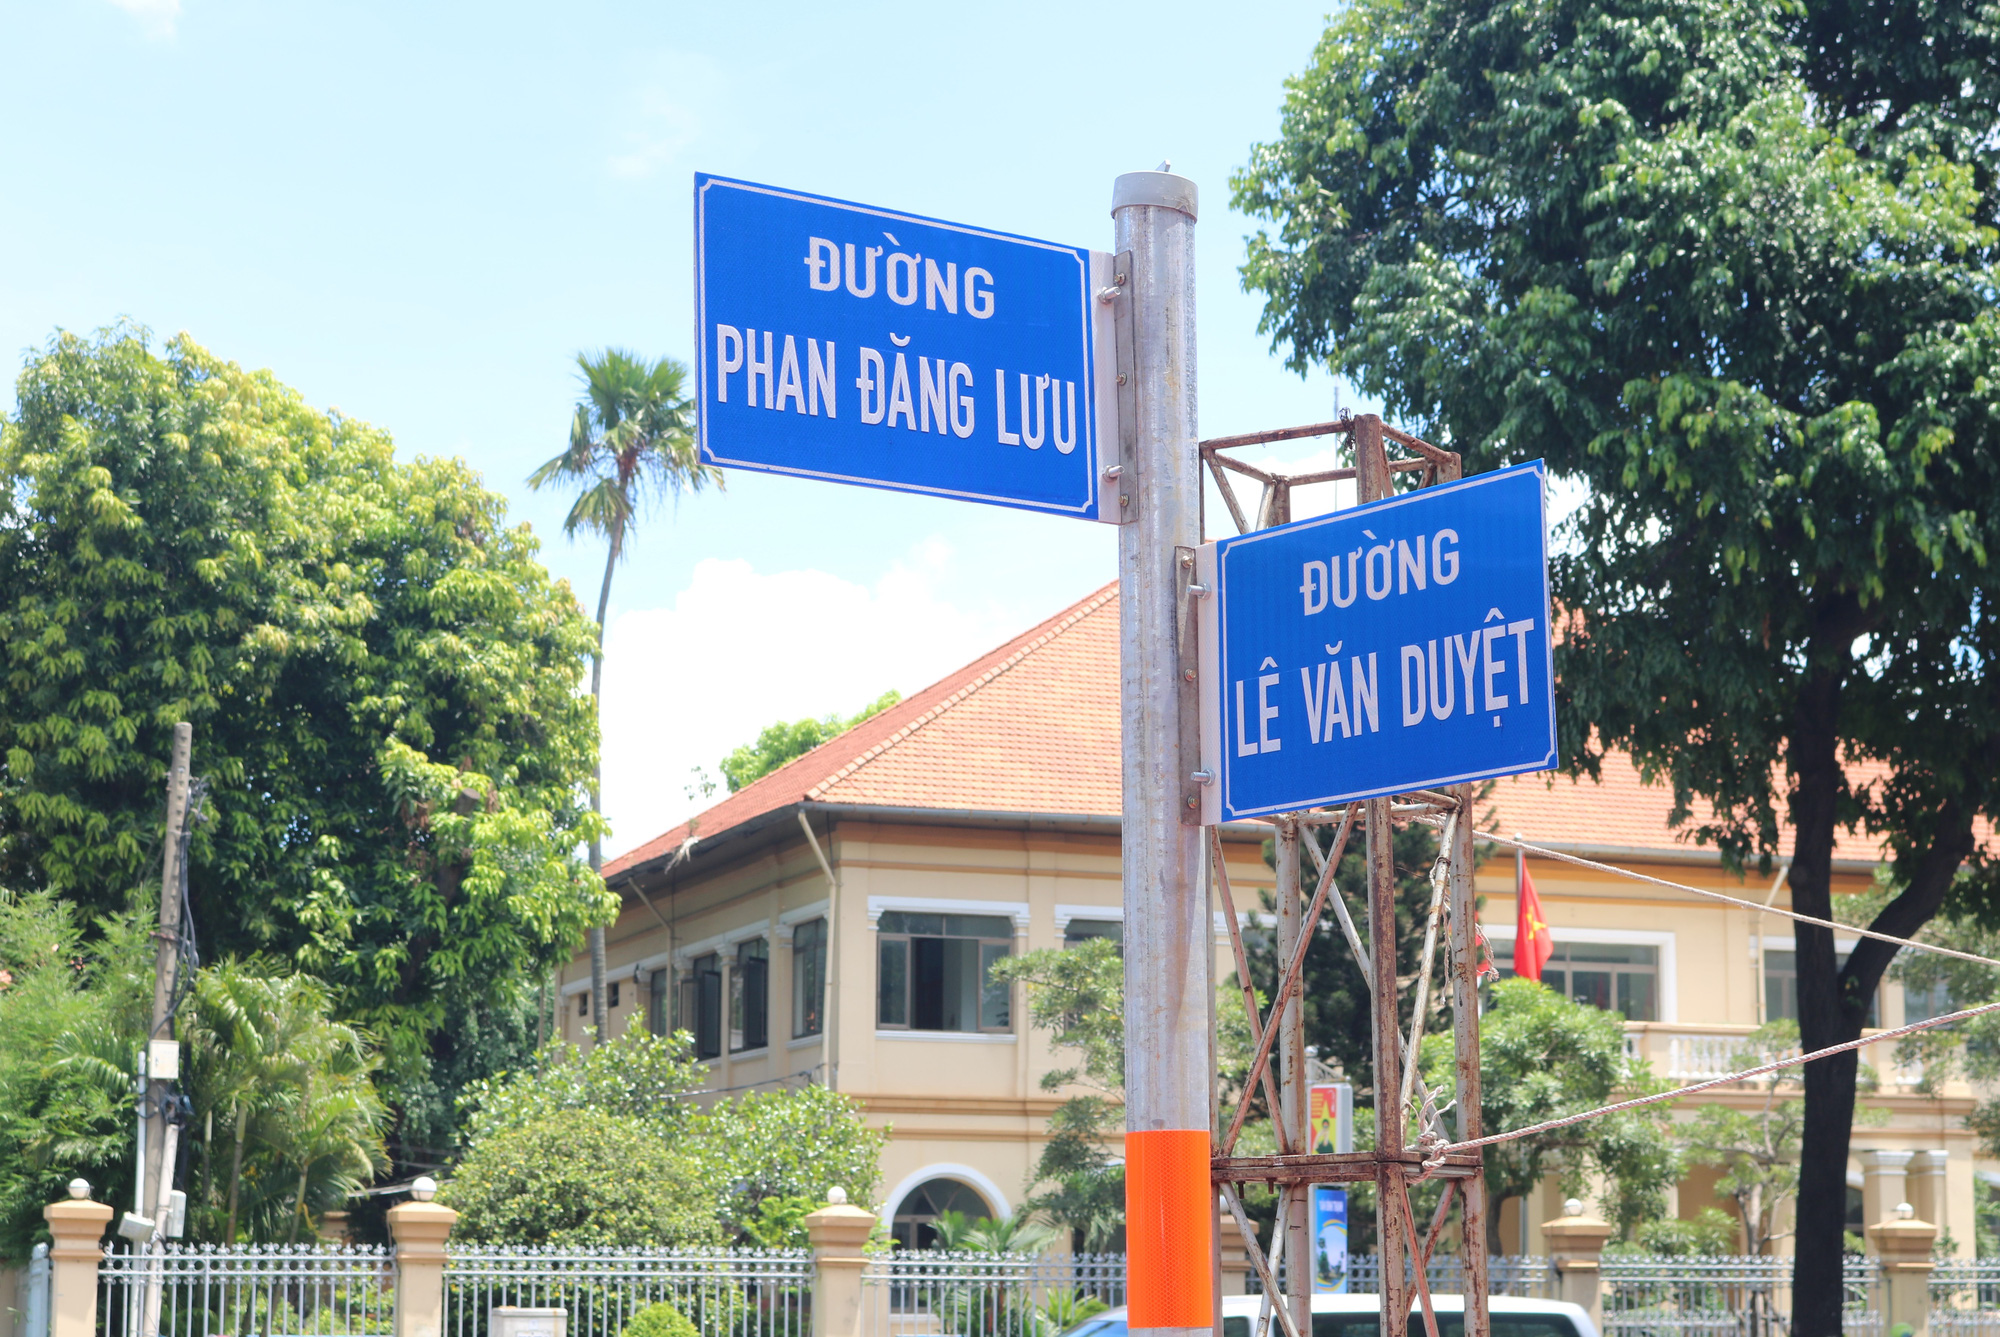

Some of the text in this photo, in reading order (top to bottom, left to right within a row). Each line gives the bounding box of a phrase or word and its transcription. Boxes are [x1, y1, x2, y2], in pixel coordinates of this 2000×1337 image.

[804, 231, 995, 320] ĐƯỜNG
[716, 323, 1078, 455] PHAN ĐĂNG LƯU
[1299, 529, 1460, 616] ĐƯỜNG
[1235, 607, 1535, 758] LÊ VĂN DUYỆT
